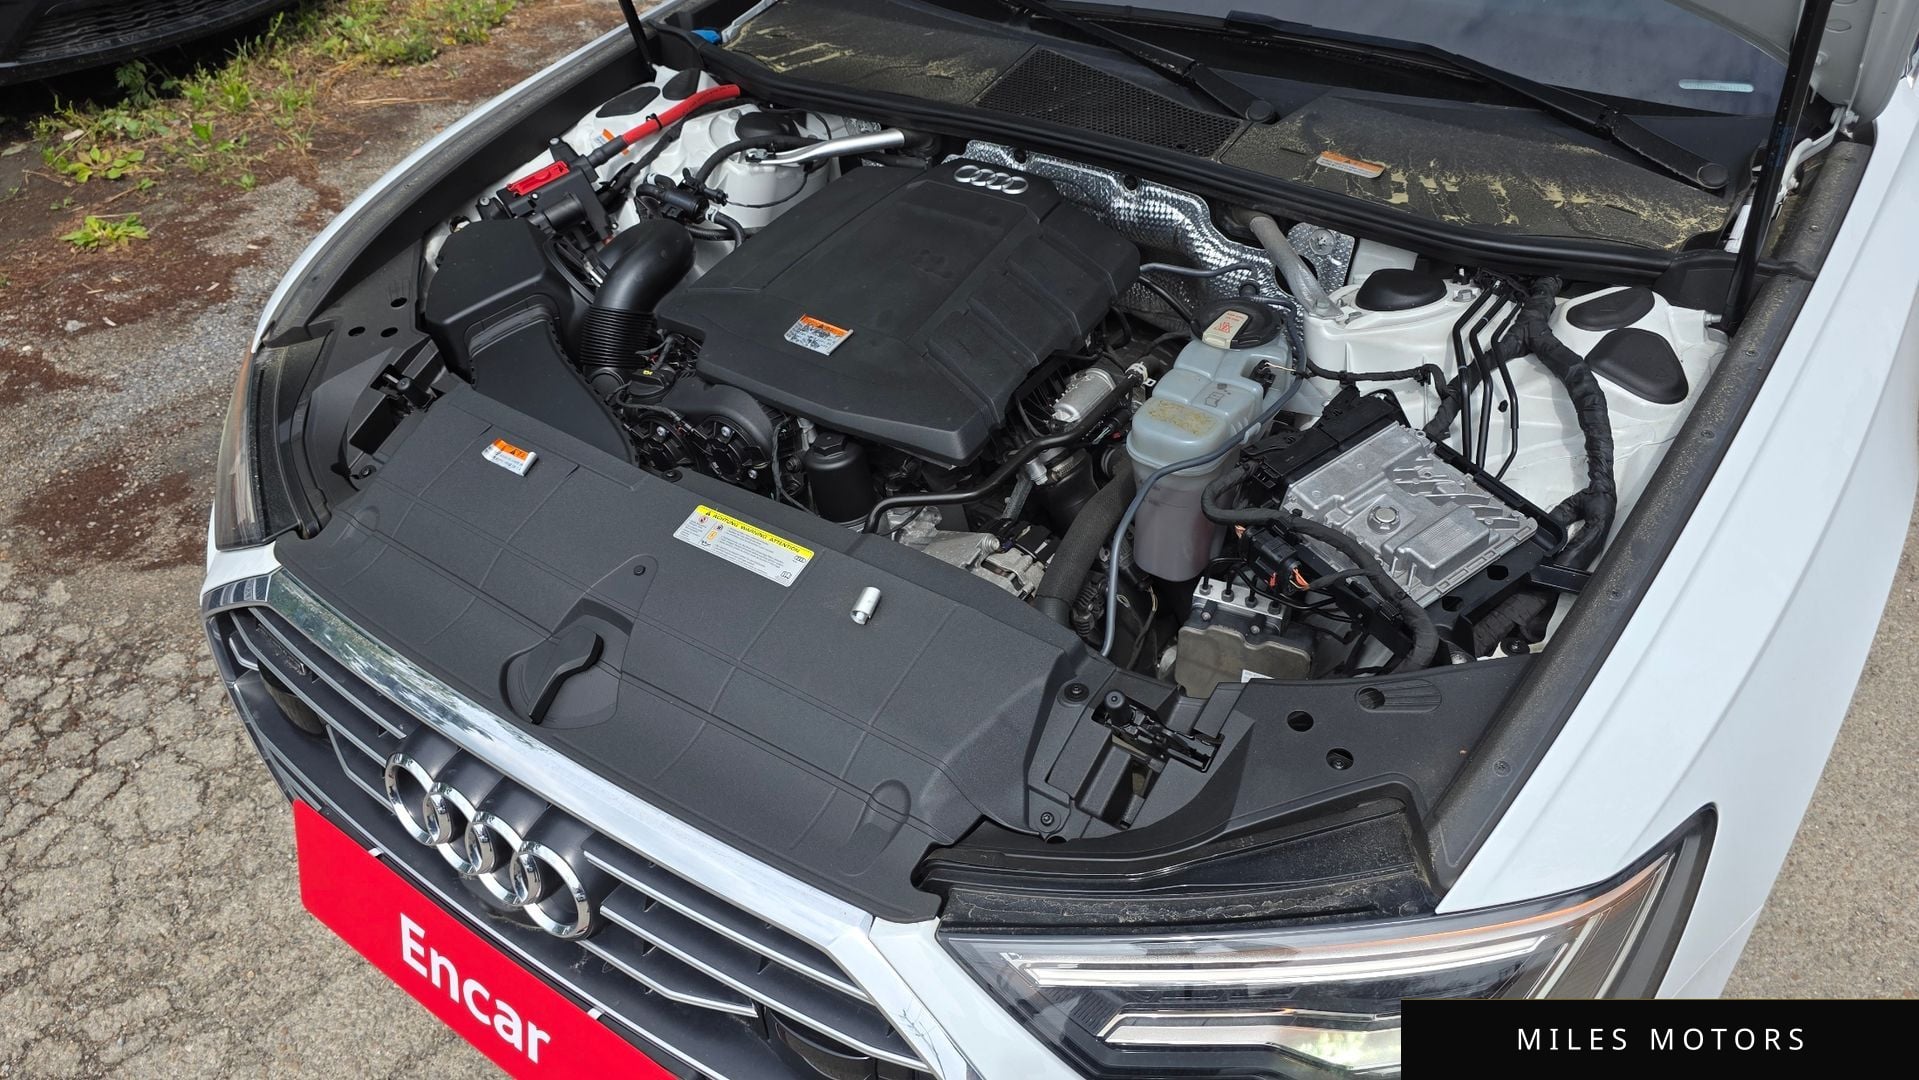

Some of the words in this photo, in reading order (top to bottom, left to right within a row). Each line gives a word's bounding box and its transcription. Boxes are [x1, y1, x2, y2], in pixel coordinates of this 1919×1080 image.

[713, 514, 738, 527] ACHTUNG
[740, 525, 767, 540] WARNING
[769, 537, 800, 553] ATTENTION
[400, 912, 551, 1064] Encar
